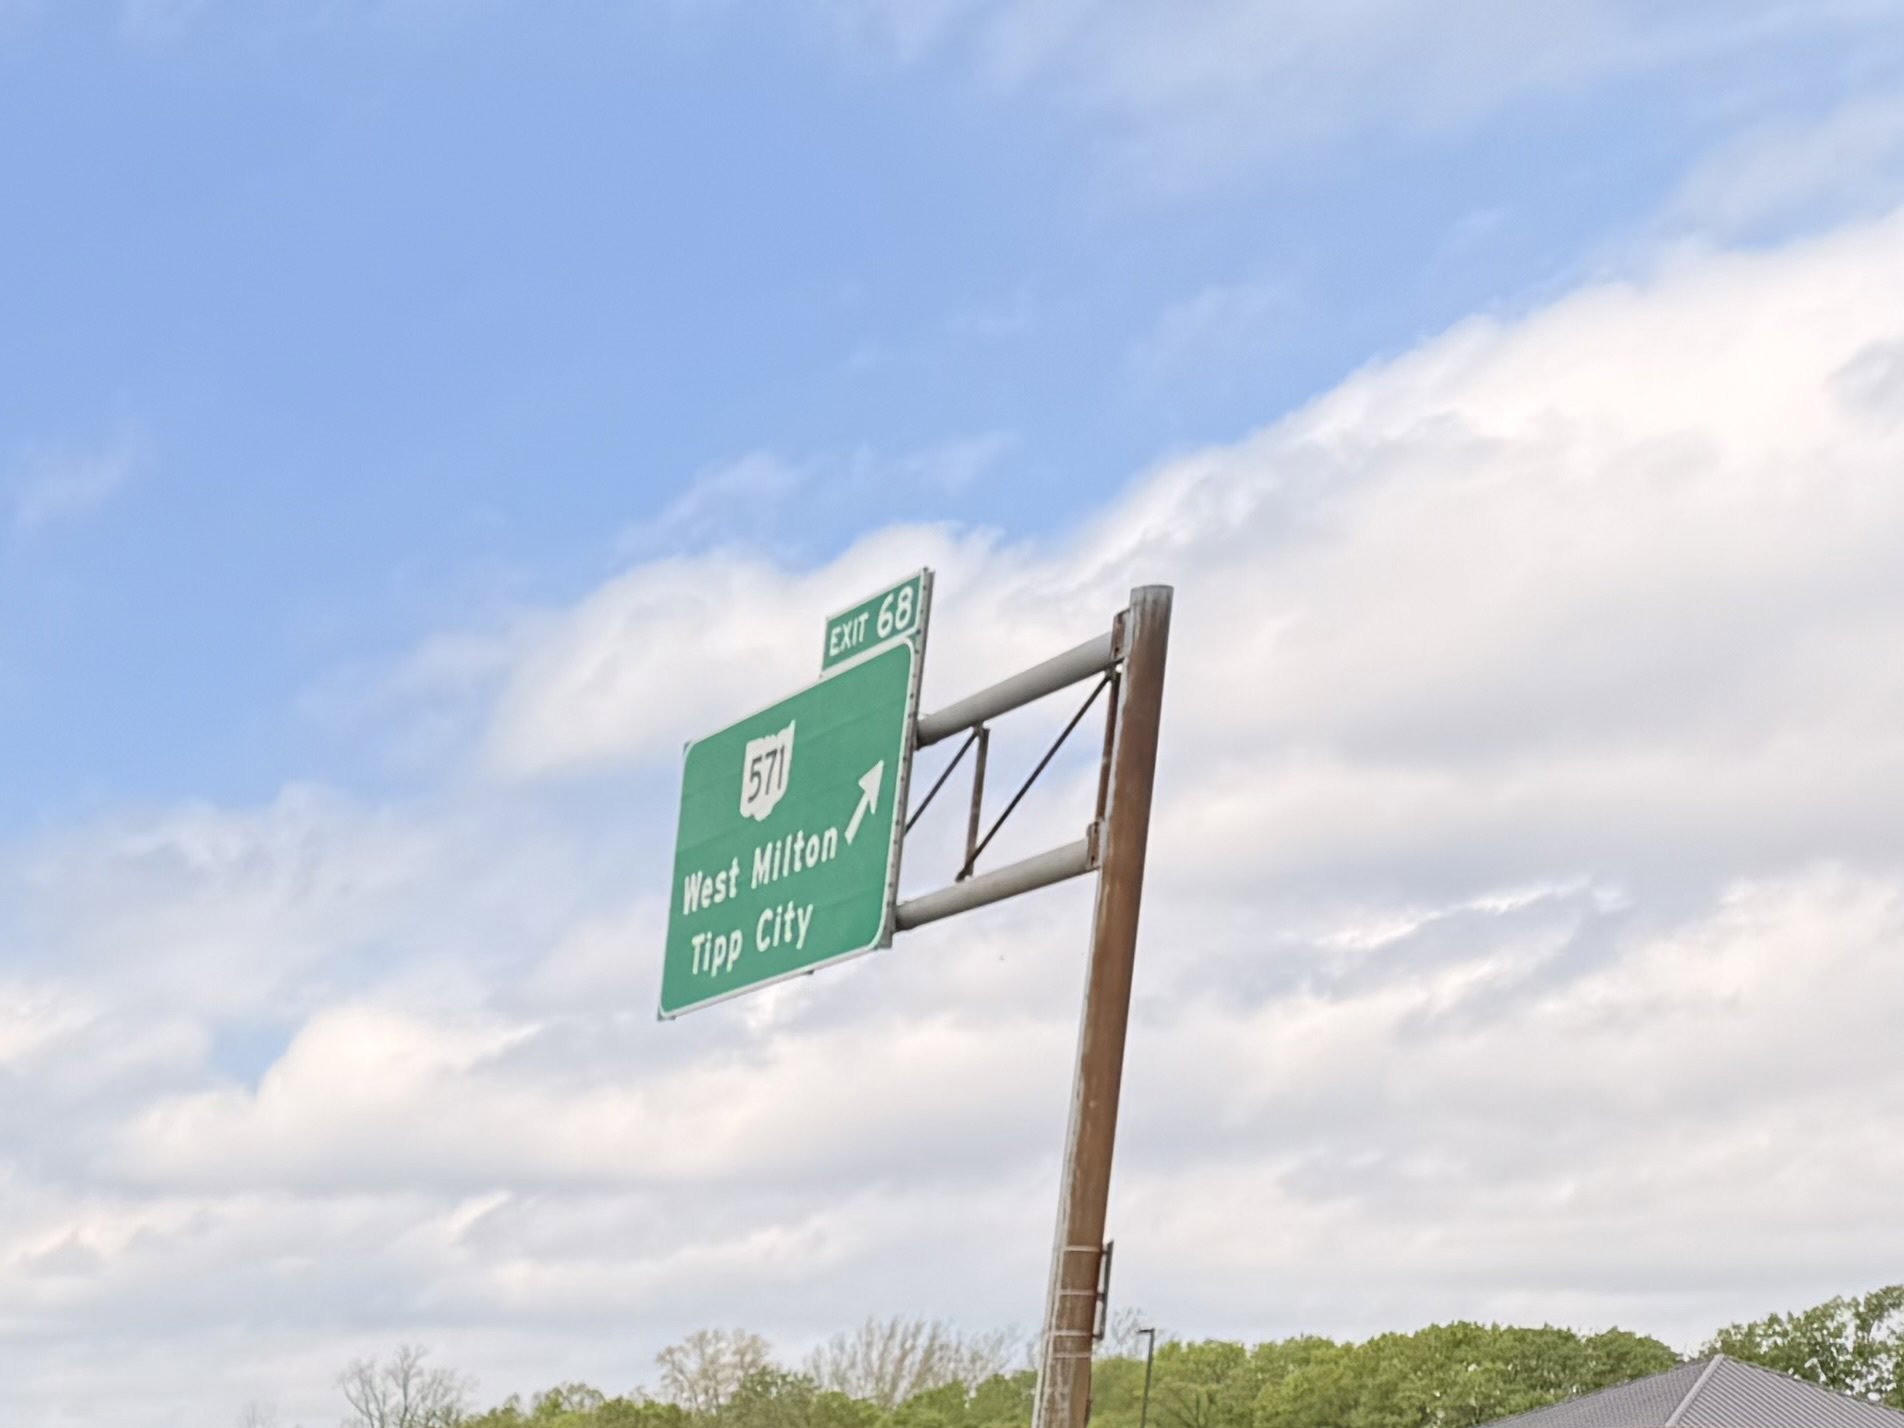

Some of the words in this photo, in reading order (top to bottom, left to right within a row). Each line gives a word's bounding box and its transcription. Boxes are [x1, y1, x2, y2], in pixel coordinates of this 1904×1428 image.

[829, 611, 869, 656] EXIT
[877, 586, 914, 638] 68
[748, 745, 786, 804] 571
[683, 857, 740, 915] West
[751, 827, 838, 889] Milton
[691, 930, 742, 977] Tipp
[756, 901, 813, 951] City
